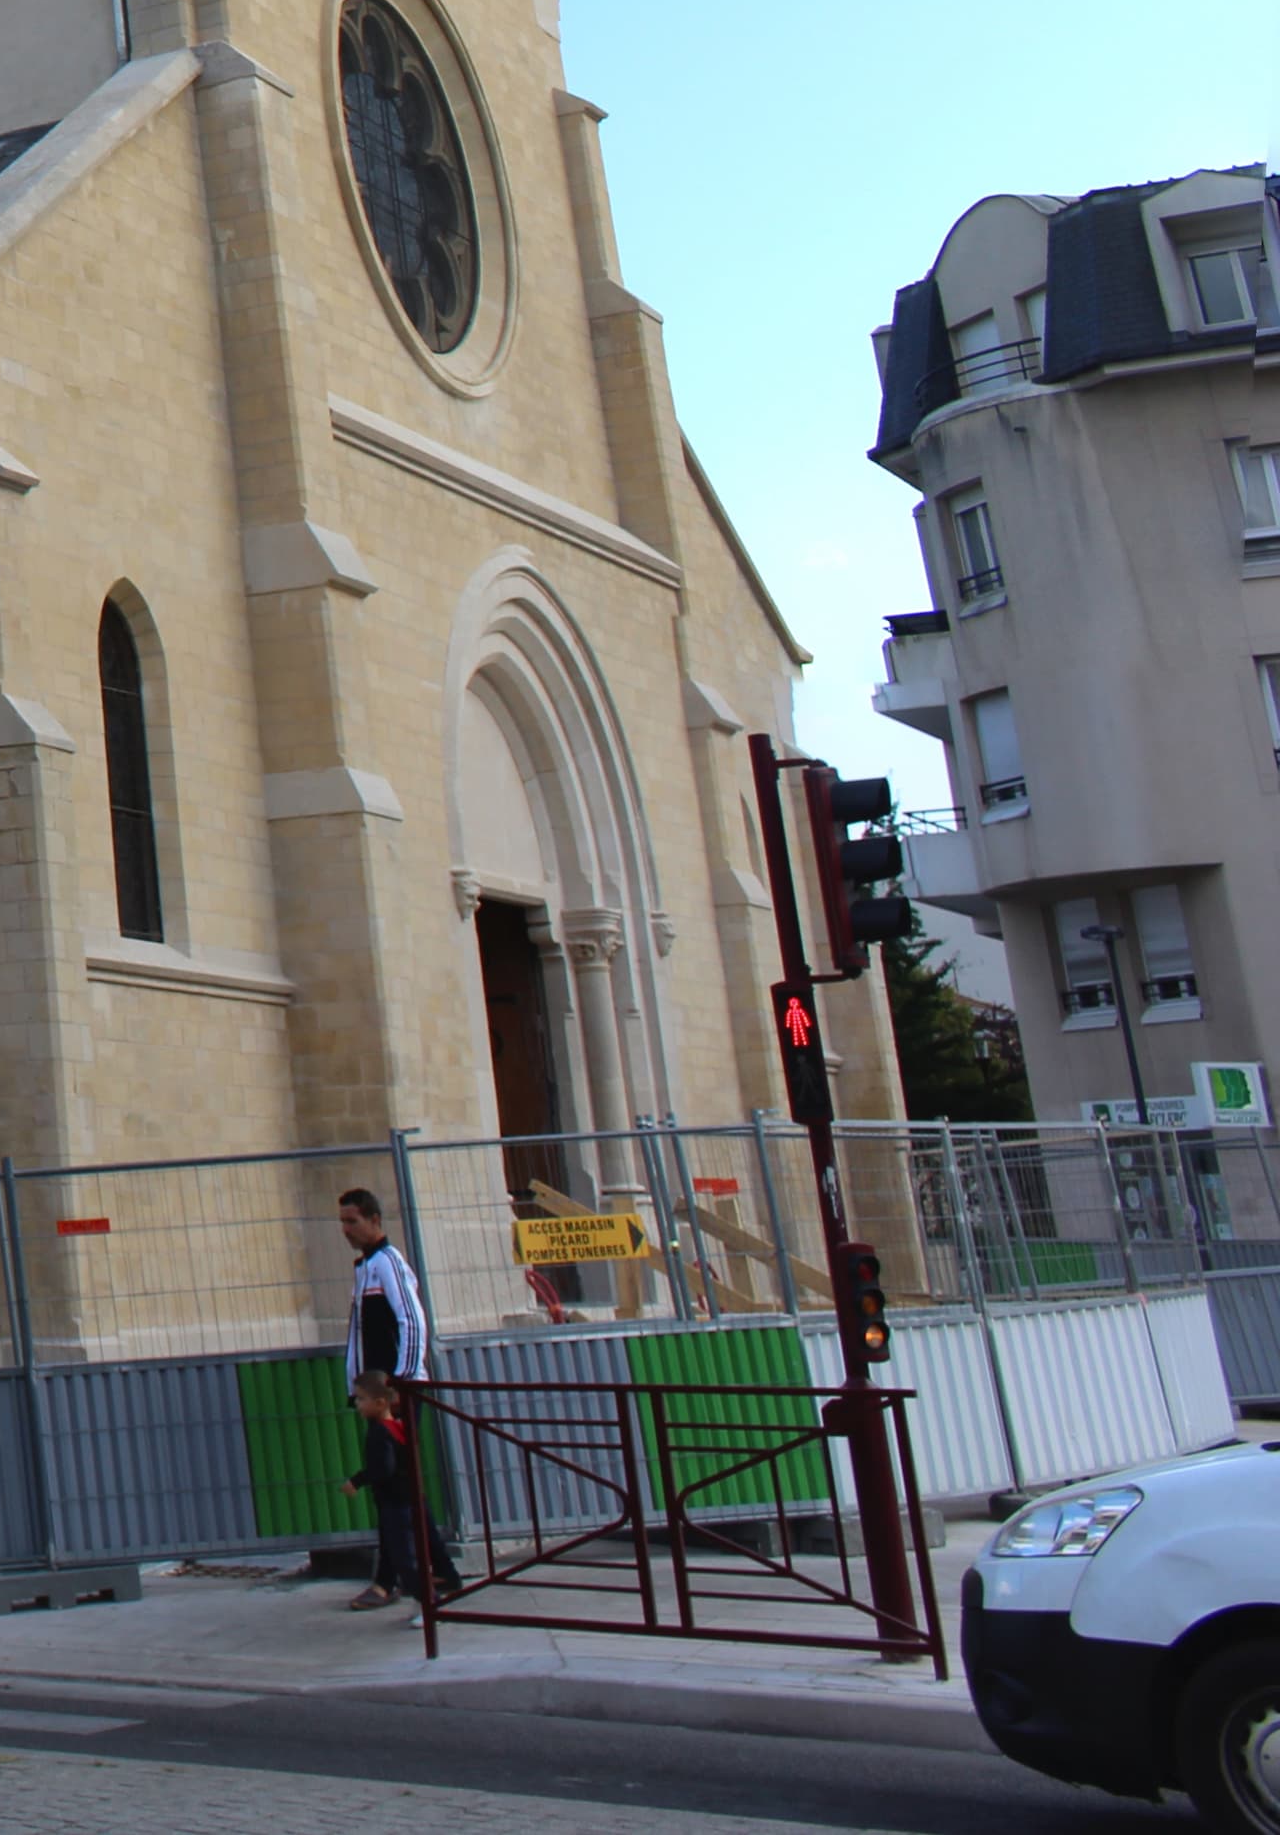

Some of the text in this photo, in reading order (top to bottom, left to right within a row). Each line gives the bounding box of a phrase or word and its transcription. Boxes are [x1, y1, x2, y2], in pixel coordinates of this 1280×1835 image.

[528, 1218, 615, 1234] ACCES MAGASIN
[550, 1234, 590, 1246] PICARD
[526, 1244, 627, 1262] POMPES FUNEBRES
